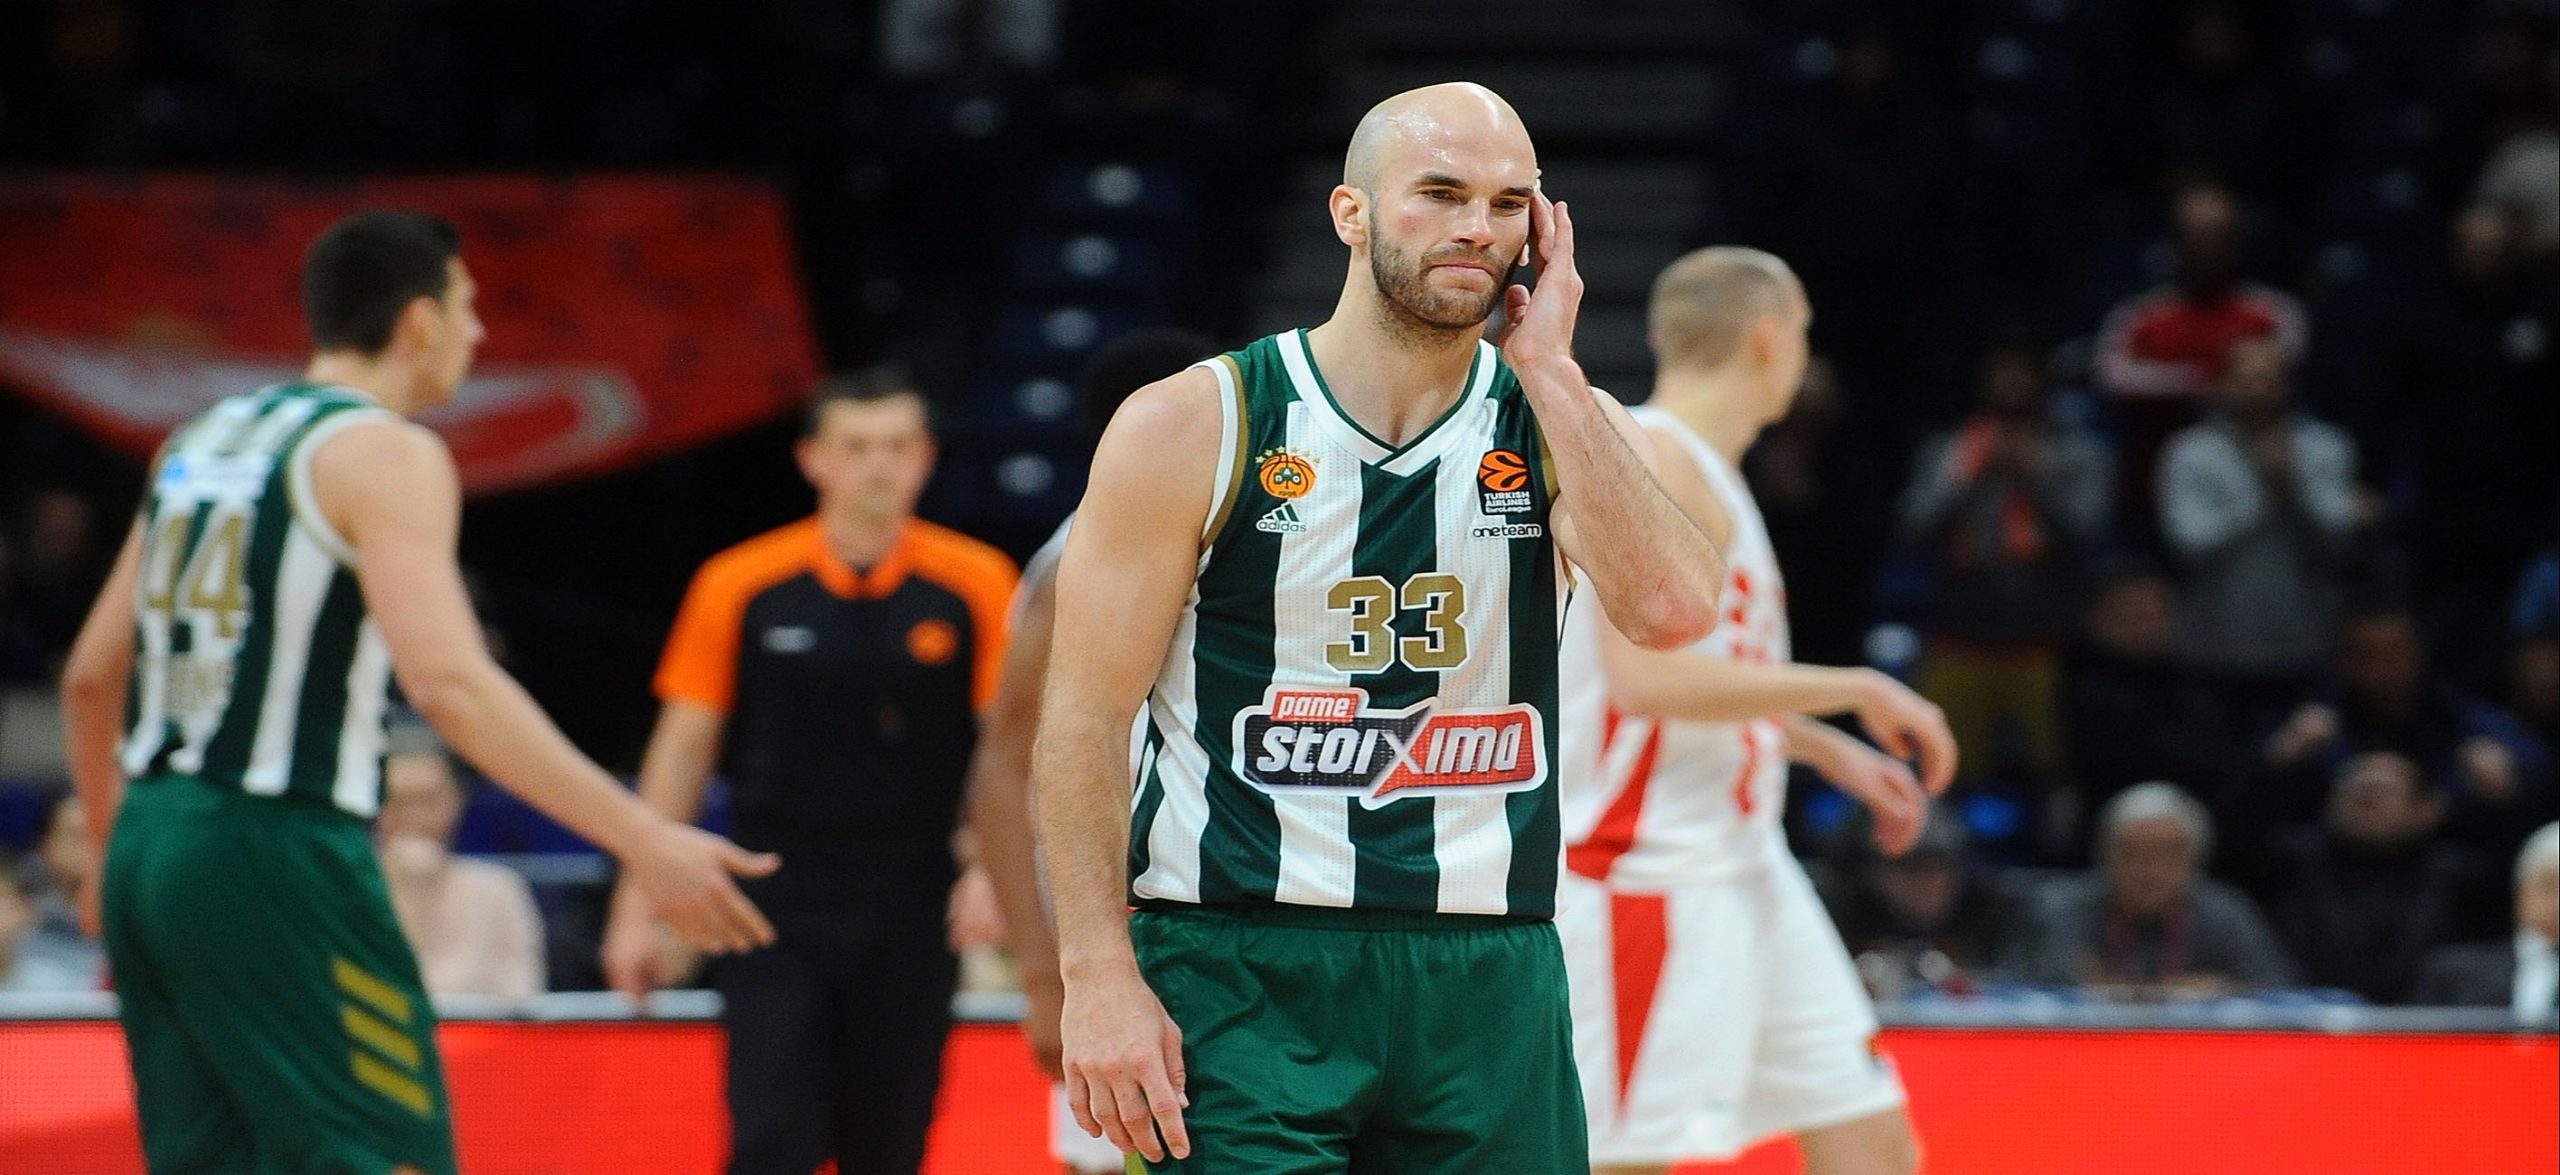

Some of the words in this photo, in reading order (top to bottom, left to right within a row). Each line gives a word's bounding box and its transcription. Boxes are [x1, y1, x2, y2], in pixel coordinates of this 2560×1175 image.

[1484, 491, 1530, 500] TURKISH
[1485, 498, 1531, 507] AIRLINES
[1258, 520, 1307, 533] adidas
[1325, 573, 1468, 673] 33
[1277, 695, 1350, 718] pame
